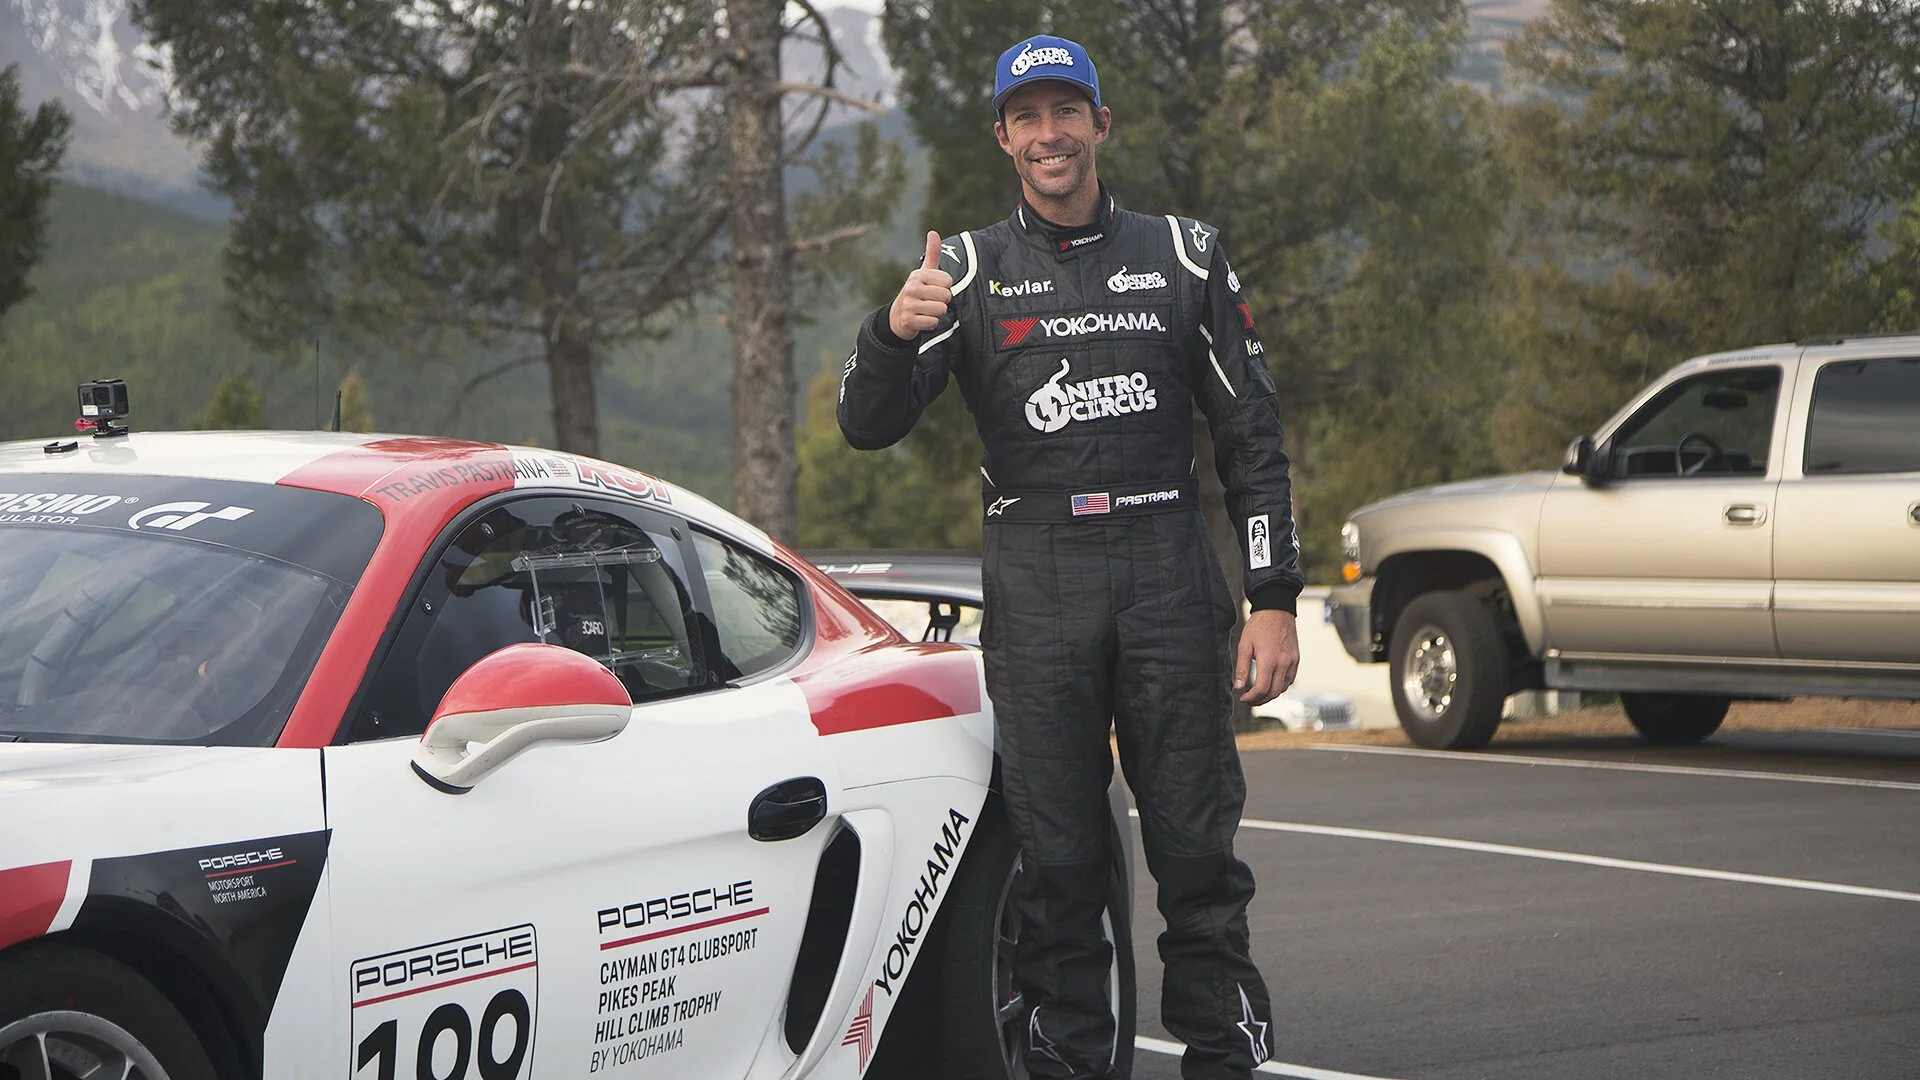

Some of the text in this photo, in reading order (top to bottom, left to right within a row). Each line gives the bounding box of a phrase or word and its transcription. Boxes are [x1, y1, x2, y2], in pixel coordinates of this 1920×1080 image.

[1070, 233, 1104, 247] YOKOHAMA
[1124, 271, 1162, 283] NITRO
[1128, 277, 1168, 290] CIRCUS
[1064, 371, 1148, 404] NITRO
[1069, 389, 1158, 422] CIRCUS
[375, 458, 550, 502] TRAVIS PASTRANA
[1115, 489, 1179, 507] PASTRANA
[198, 847, 284, 871] PORSCHE
[208, 875, 255, 892] MOTORSPORT
[212, 886, 267, 904] NORTH AMERICA
[597, 880, 753, 934] PORSCHE
[874, 808, 970, 997] YOKOHAMA
[356, 932, 533, 993] PORSCHE
[600, 928, 758, 985] CAYMAN GT4 CLUBSPORT
[598, 975, 677, 1015] PIKES PEAK
[594, 991, 722, 1044] HILL CLIMB TROPHY
[590, 1028, 684, 1073] BY YOKOHAMA
